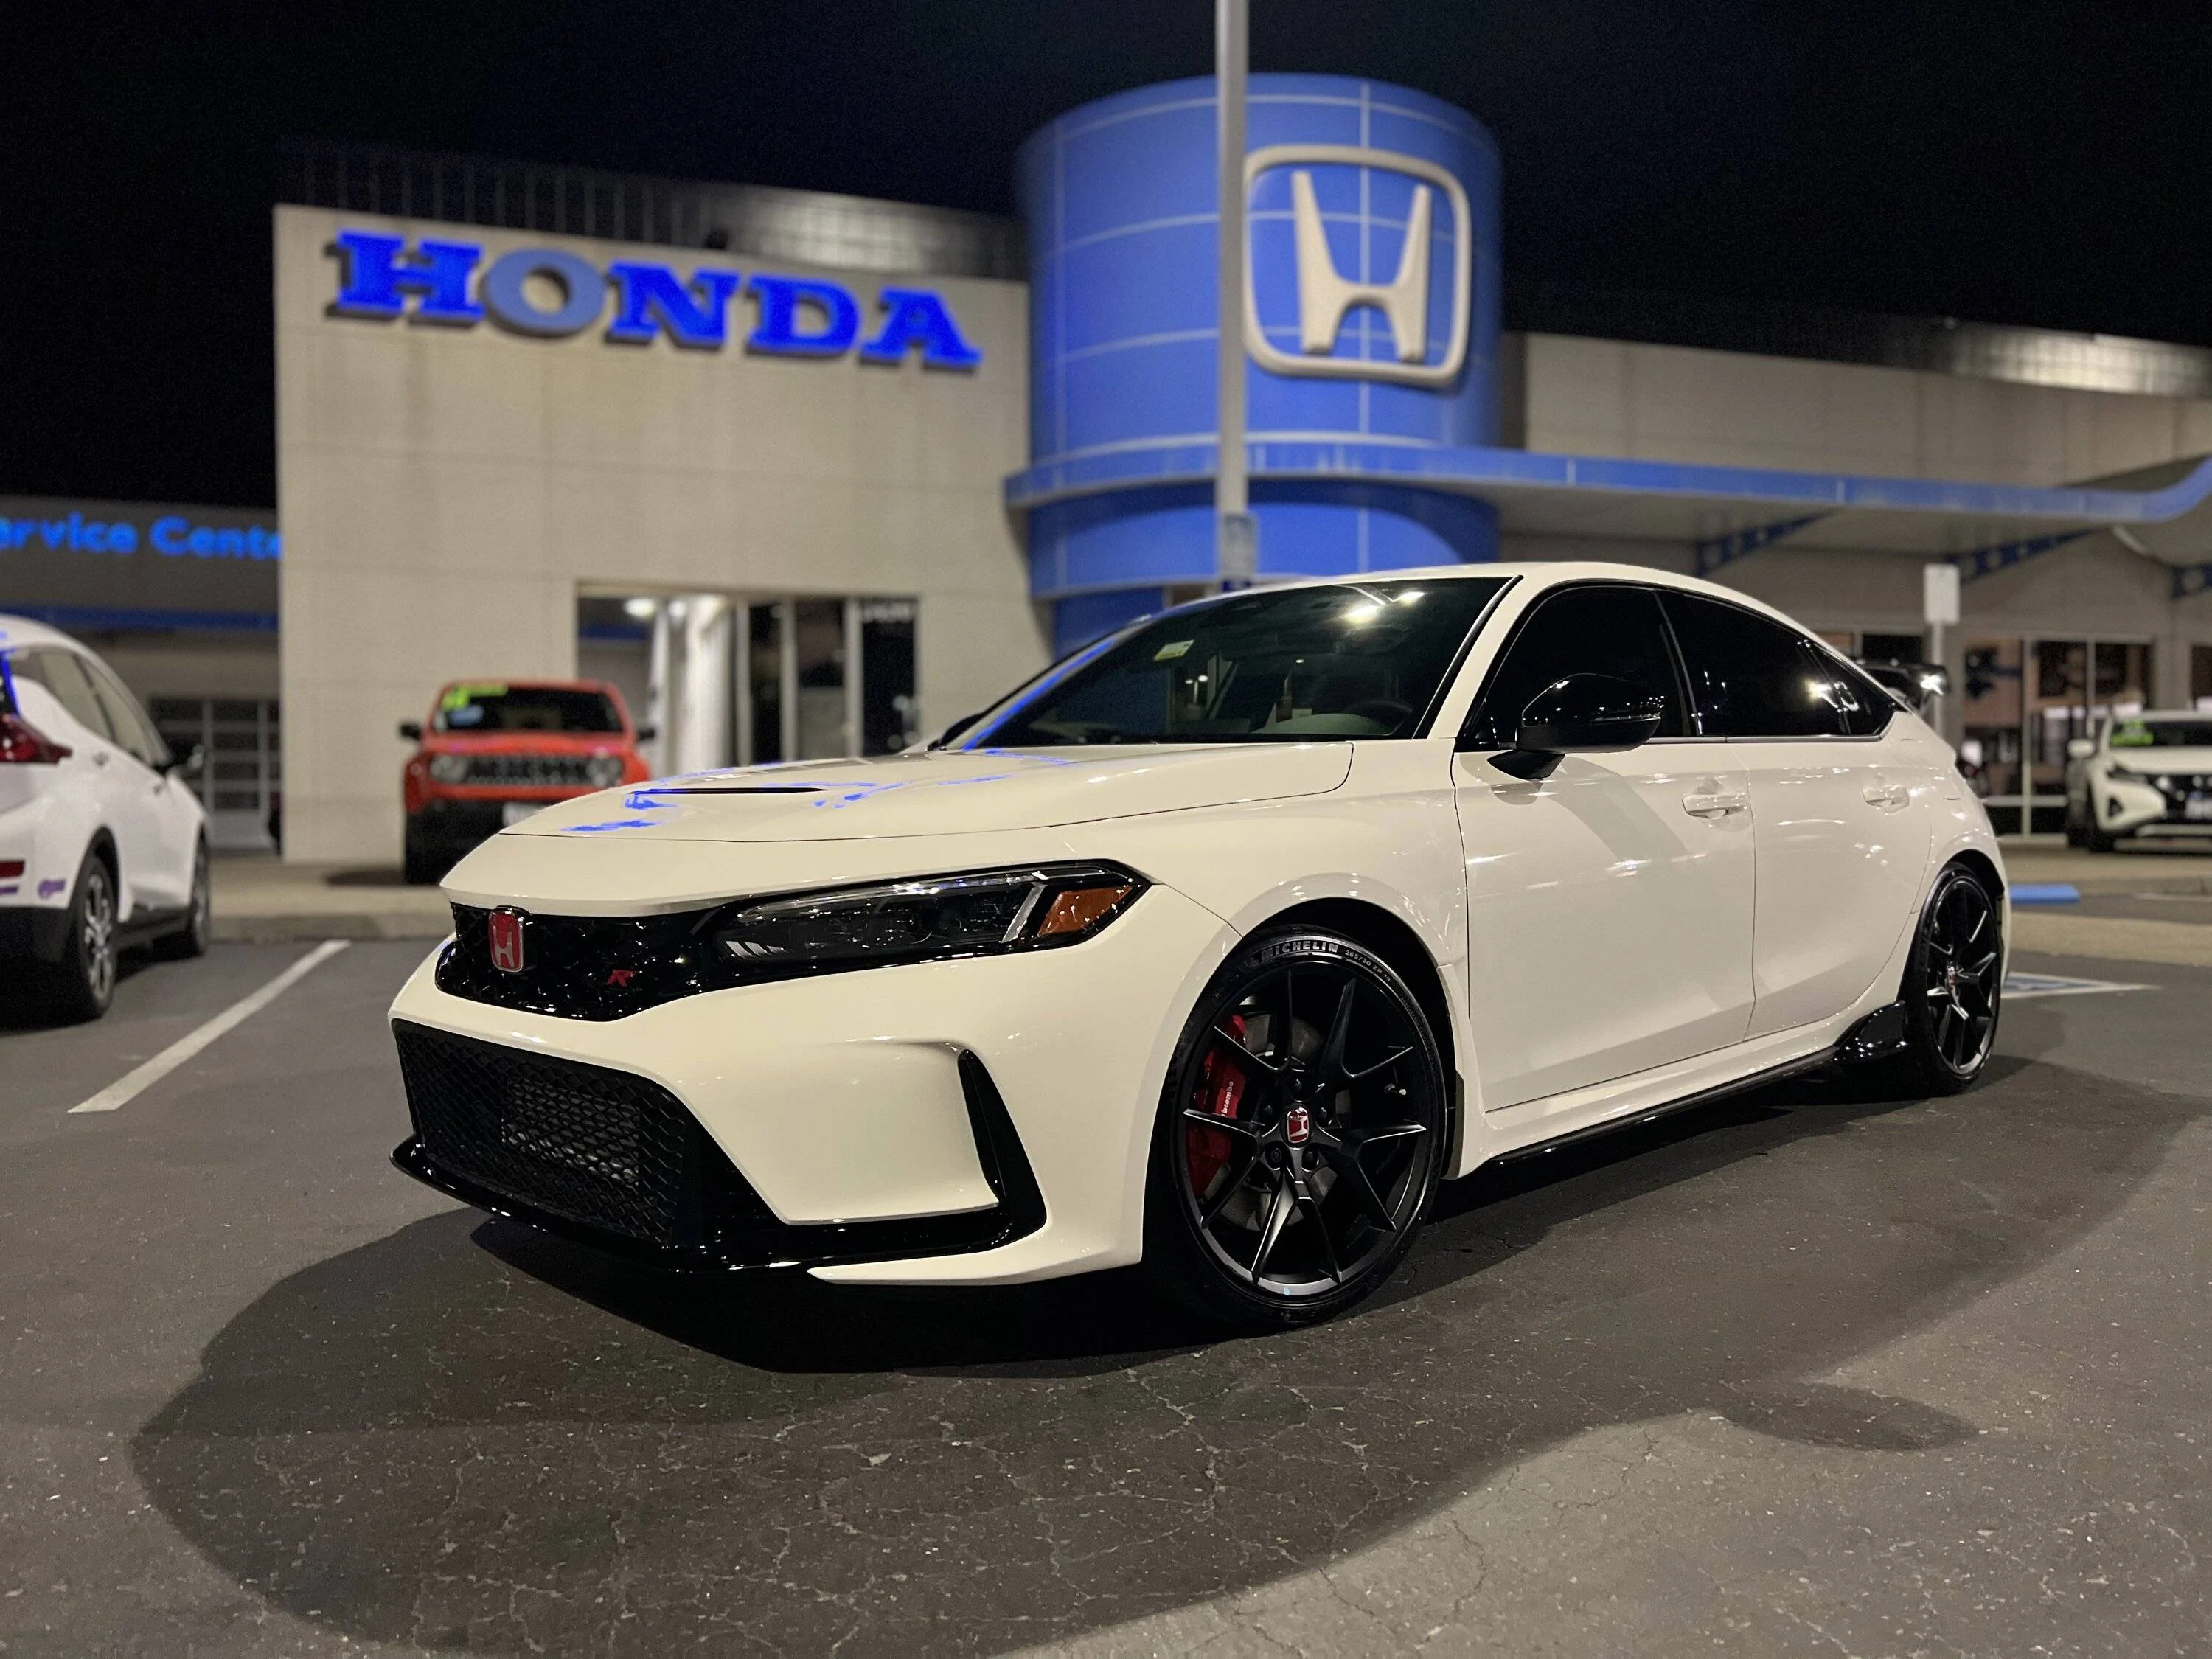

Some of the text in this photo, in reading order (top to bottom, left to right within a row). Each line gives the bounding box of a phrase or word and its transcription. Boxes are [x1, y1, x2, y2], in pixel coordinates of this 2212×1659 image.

[328, 229, 982, 371] HONDA
[1261, 940, 1338, 961] MICHELIN
[1345, 949, 1371, 967] 265/30
[1221, 1081, 1234, 1114] brembo
